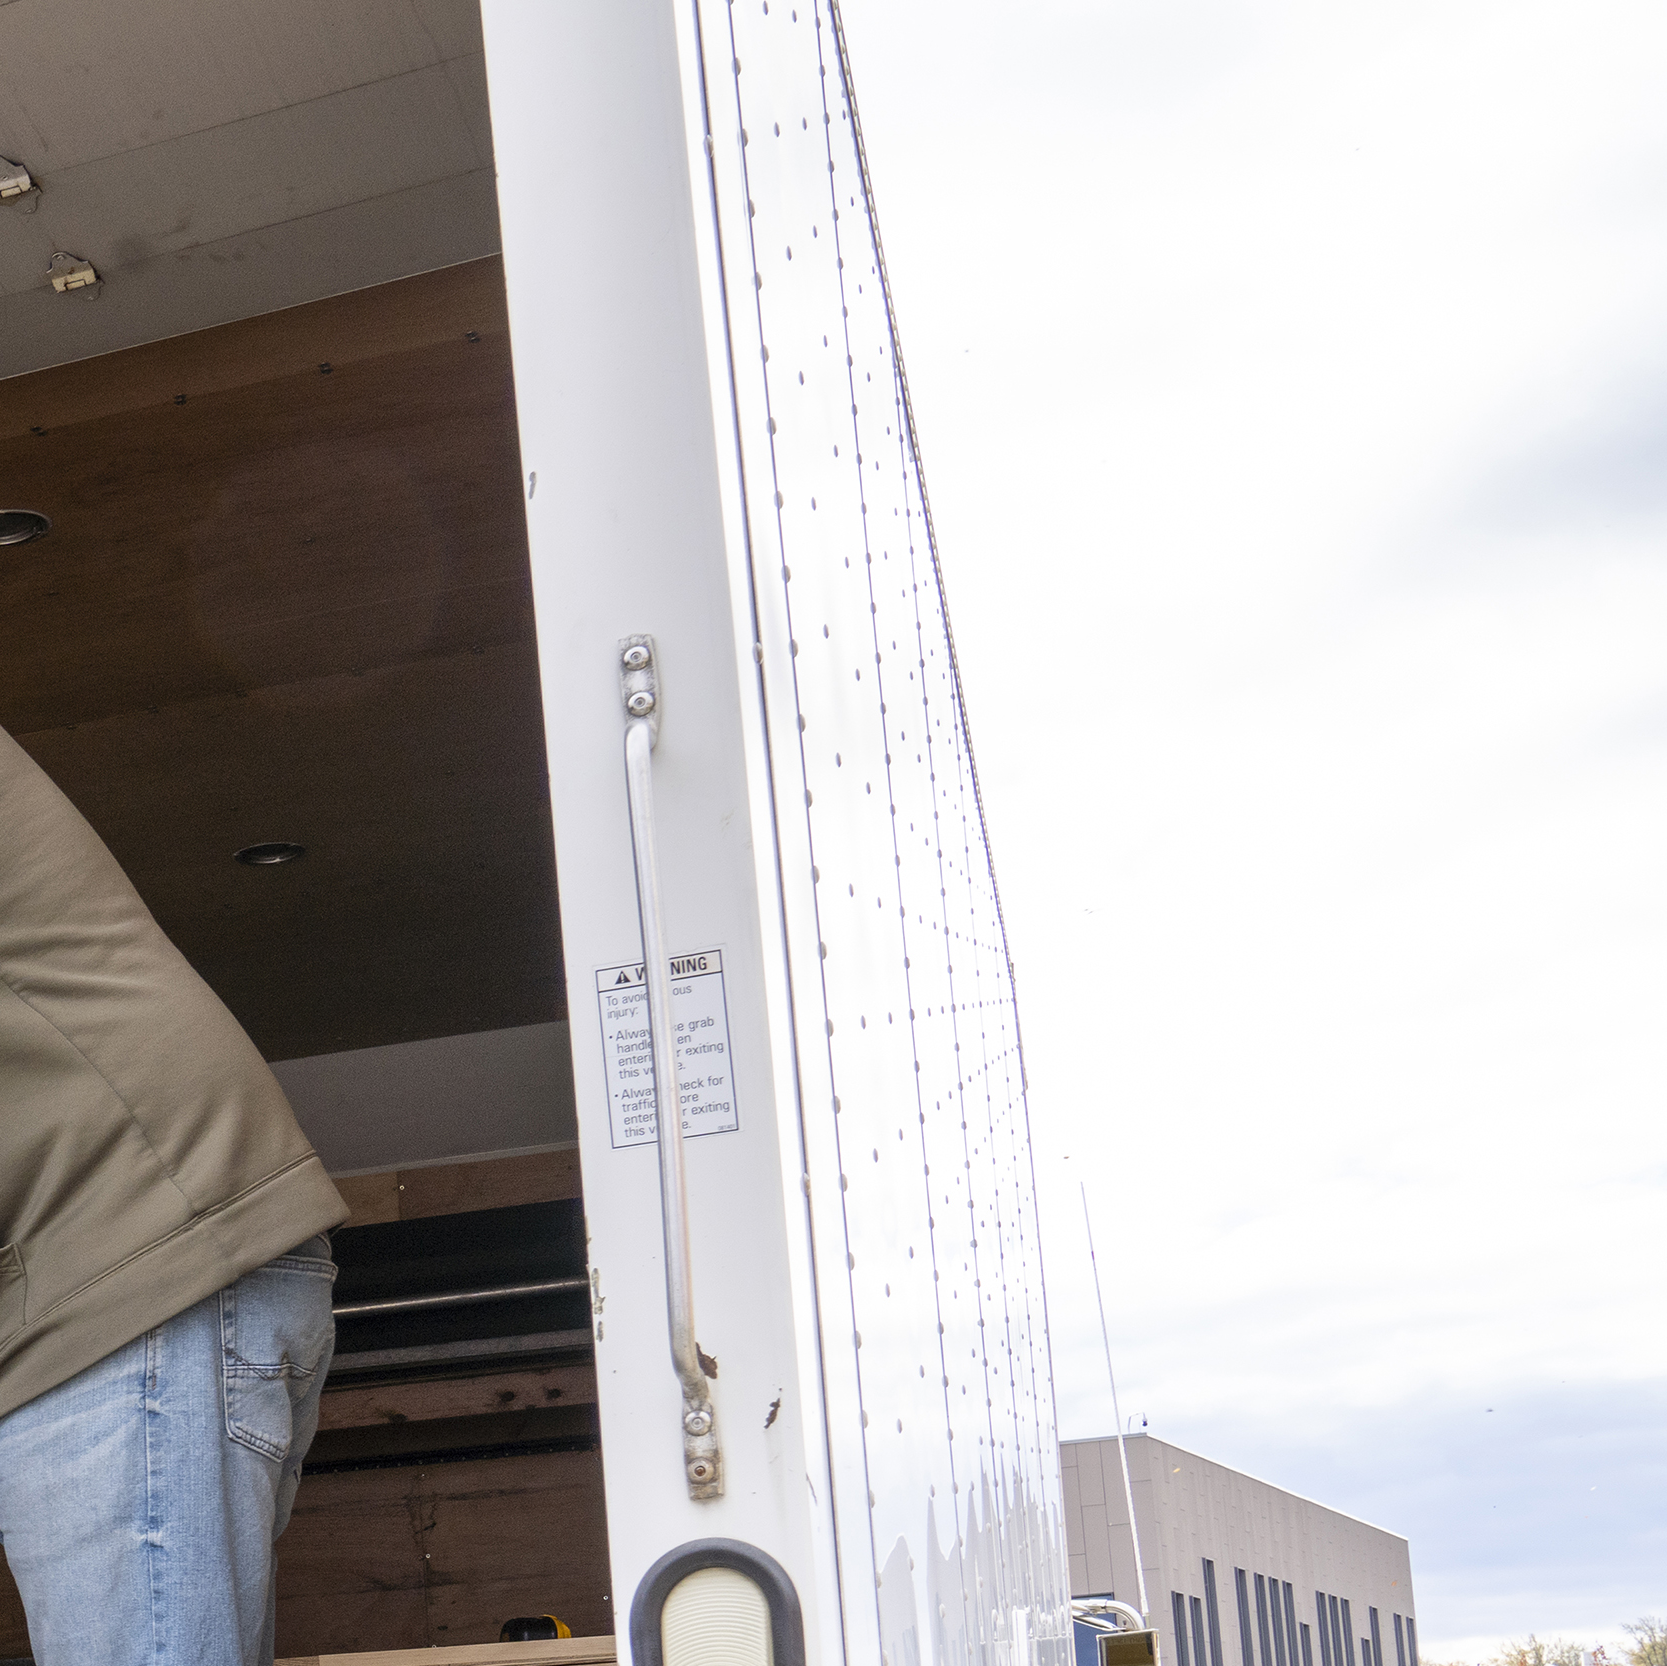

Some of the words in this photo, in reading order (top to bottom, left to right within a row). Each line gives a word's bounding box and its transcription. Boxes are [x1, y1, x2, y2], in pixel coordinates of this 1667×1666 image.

[635, 956, 707, 981] WNING
[605, 995, 618, 1006] To
[607, 1007, 639, 1020] injury:
[688, 1017, 714, 1032] grab
[618, 1052, 652, 1067] enteri
[685, 1042, 724, 1056] exiting
[619, 1067, 640, 1079] this
[707, 1075, 724, 1086] for
[691, 1101, 730, 1115] exiting
[624, 1126, 645, 1138] this
